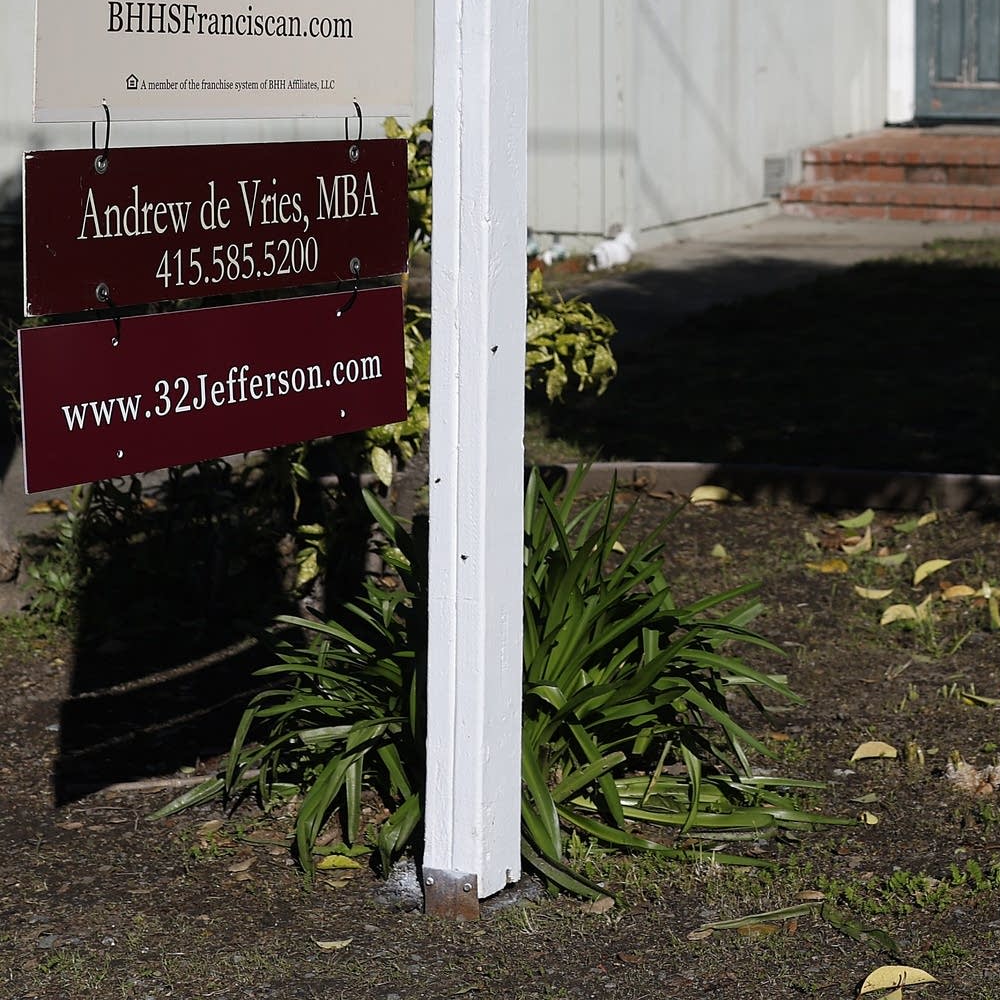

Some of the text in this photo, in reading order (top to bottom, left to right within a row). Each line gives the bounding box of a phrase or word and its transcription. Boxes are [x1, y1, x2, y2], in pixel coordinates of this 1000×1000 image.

[107, 1, 353, 39] BHHSFranciscan.com
[140, 79, 335, 92] A member of the franchise system of BHH Affiliates, LLC
[76, 171, 379, 240] Andrew de Vries, MBA
[155, 237, 319, 288] 415.585.5200
[62, 354, 383, 432] www.32Jefferson.com
